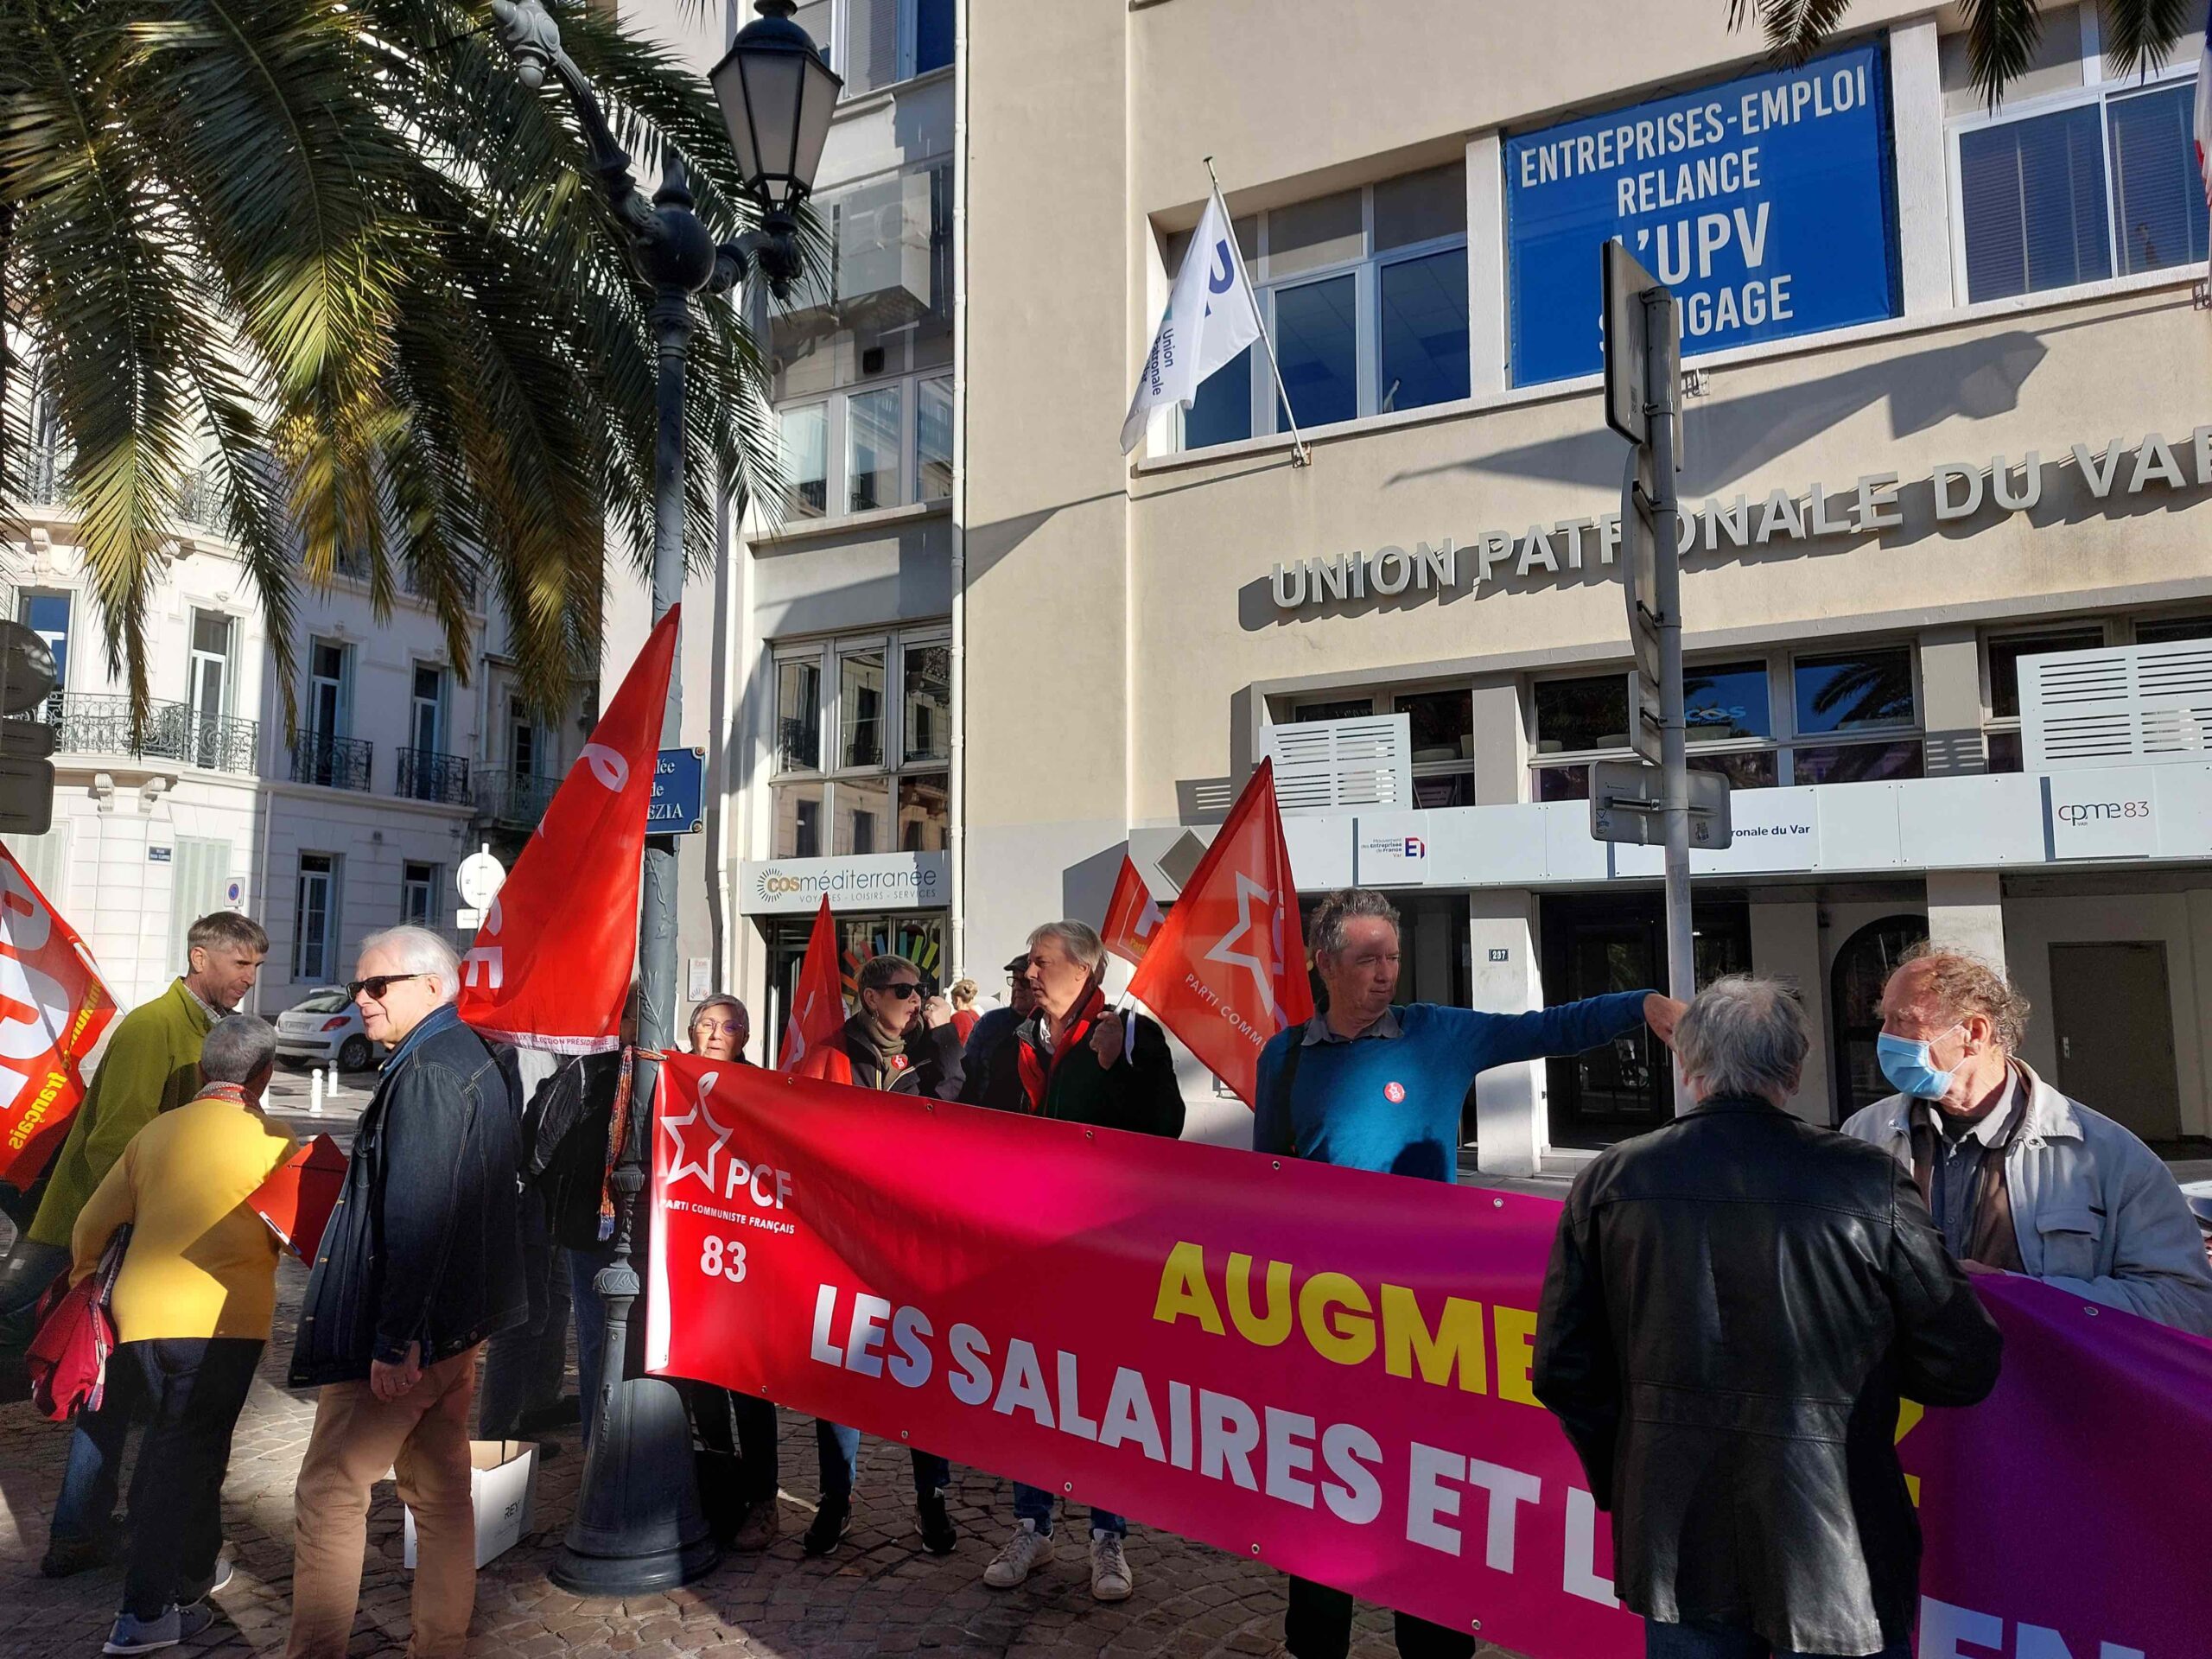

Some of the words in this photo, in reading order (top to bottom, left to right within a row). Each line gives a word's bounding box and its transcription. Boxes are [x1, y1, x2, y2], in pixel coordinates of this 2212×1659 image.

[1521, 65, 1866, 188] ENTREPRISES-EMPLOI
[1618, 146, 1761, 218] RELANCE
[1611, 201, 1770, 286] 'UPV
[1162, 328, 1175, 368] Union
[1270, 537, 1456, 608] UNION
[1932, 450, 2043, 520] DU
[654, 759, 676, 774] lée
[647, 802, 684, 820] EZIA
[1771, 825, 1787, 836] du
[1789, 824, 1811, 835] Var
[851, 892, 884, 901] LOISIRS
[893, 888, 937, 899] SERVICES
[1492, 950, 1506, 960] 237
[1185, 973, 1219, 1007] PARTI
[724, 1158, 794, 1210] PCF
[659, 1198, 689, 1211] PARTI
[691, 1204, 747, 1224] COMMUNISTE
[748, 1217, 795, 1234] FRANÇAIS
[700, 1235, 747, 1283] 83
[1153, 1241, 1548, 1409] AUGME
[810, 1283, 934, 1389] LES
[948, 1322, 1383, 1525] SALAIRES
[1406, 1441, 1542, 1575] ET
